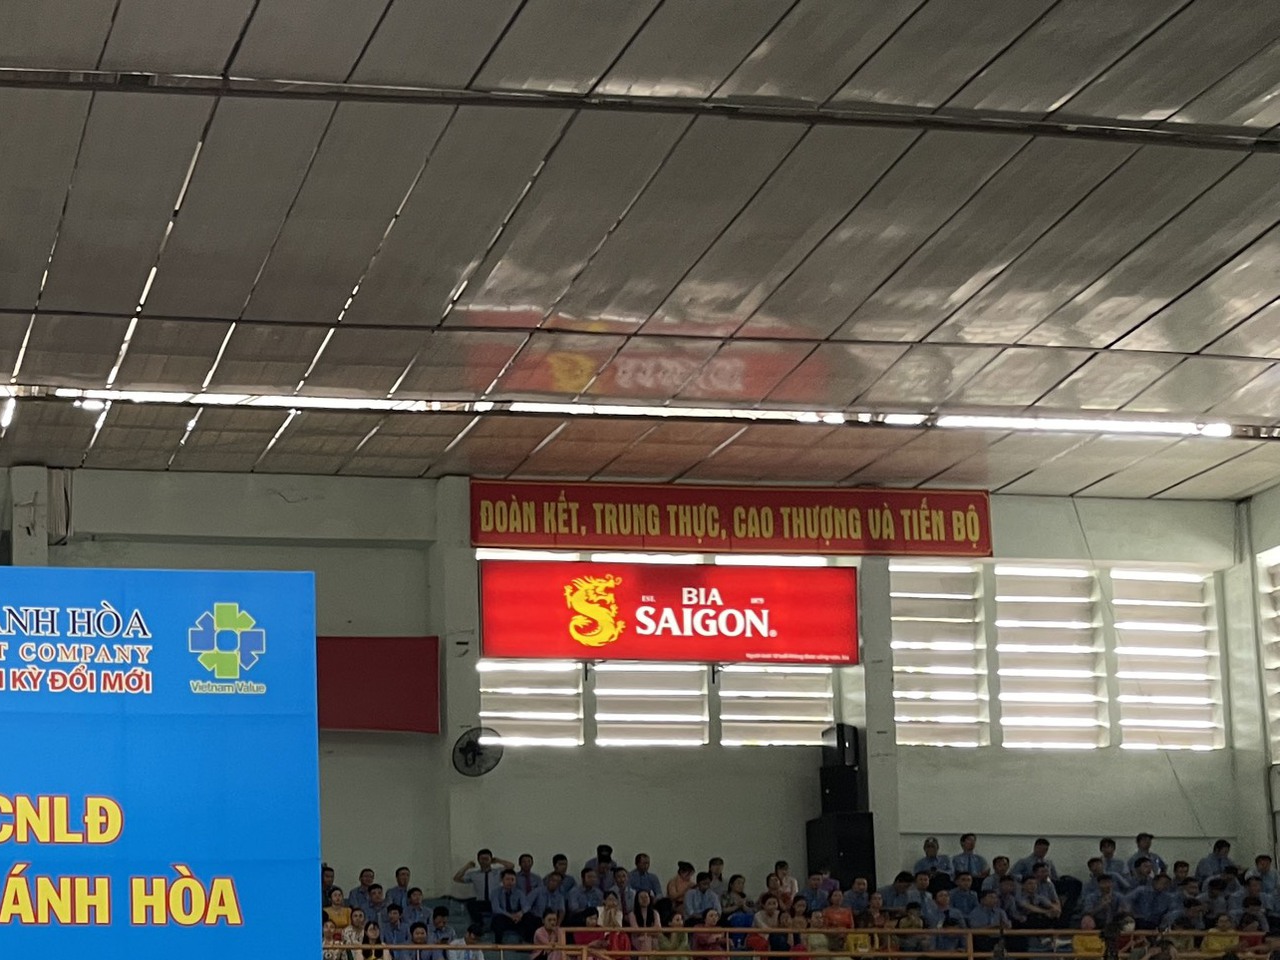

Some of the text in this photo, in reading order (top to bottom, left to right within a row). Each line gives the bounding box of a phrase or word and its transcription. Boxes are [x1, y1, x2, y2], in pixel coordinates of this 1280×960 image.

[480, 490, 980, 548] ĐOÀN KẾT, TRUNG THỰC, CAO THƯỢNG VÀ TIẾN BỘ
[682, 587, 724, 605] BIA
[67, 600, 152, 639] HÒA
[19, 643, 152, 664] COMPANY
[10, 665, 45, 691] KỲ
[48, 662, 95, 692] ĐỔI
[101, 665, 152, 694] MỚI
[189, 680, 266, 694] Vietnam Value
[129, 863, 243, 926] HÒA
